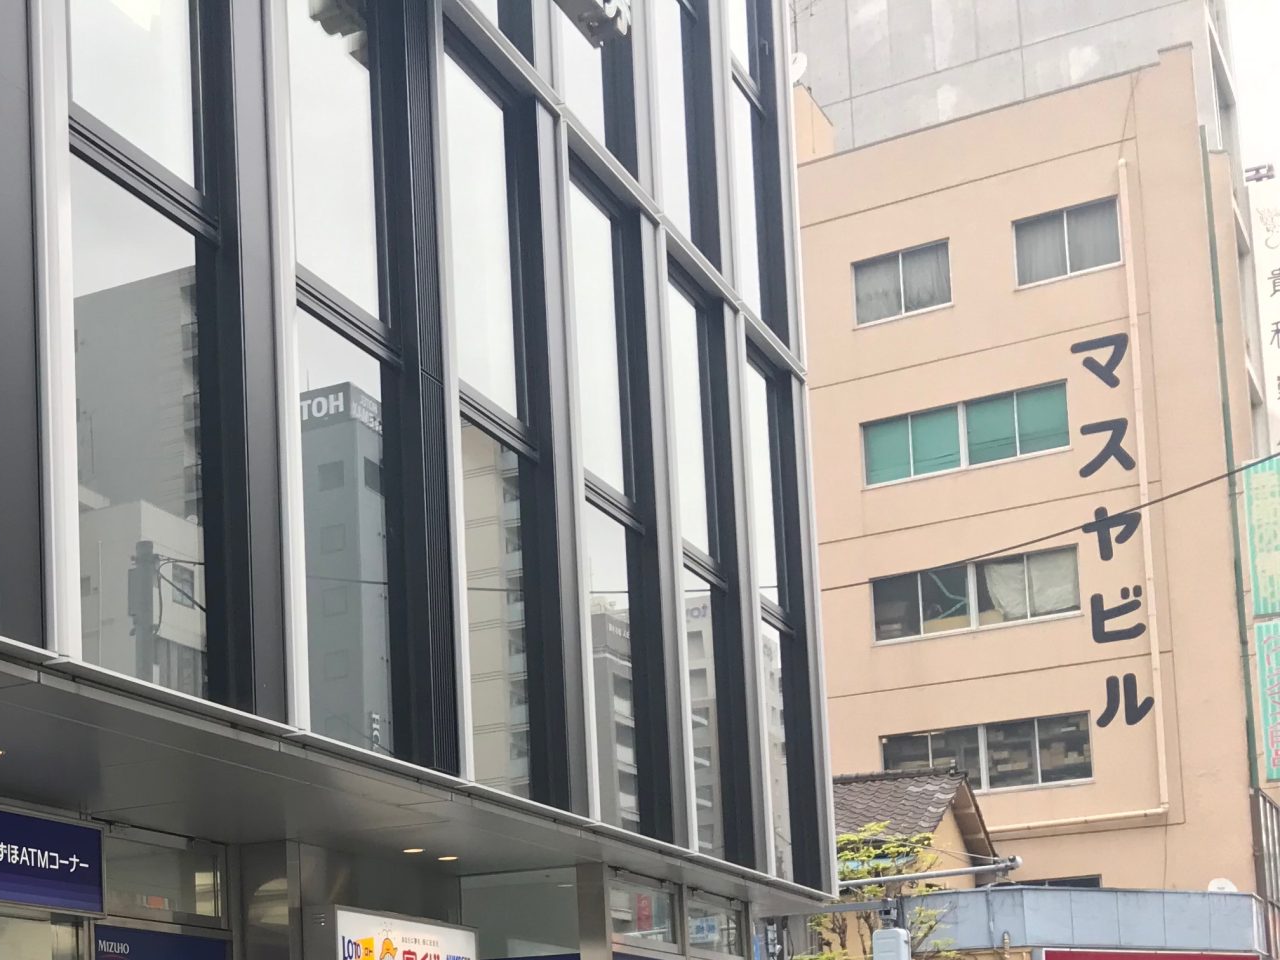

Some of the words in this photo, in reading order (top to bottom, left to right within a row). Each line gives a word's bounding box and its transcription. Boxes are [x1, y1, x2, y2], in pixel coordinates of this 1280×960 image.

[1070, 332, 1155, 729] マスヤビル
[98, 939, 130, 955] MIZUHO
[342, 935, 361, 960] LOTO
